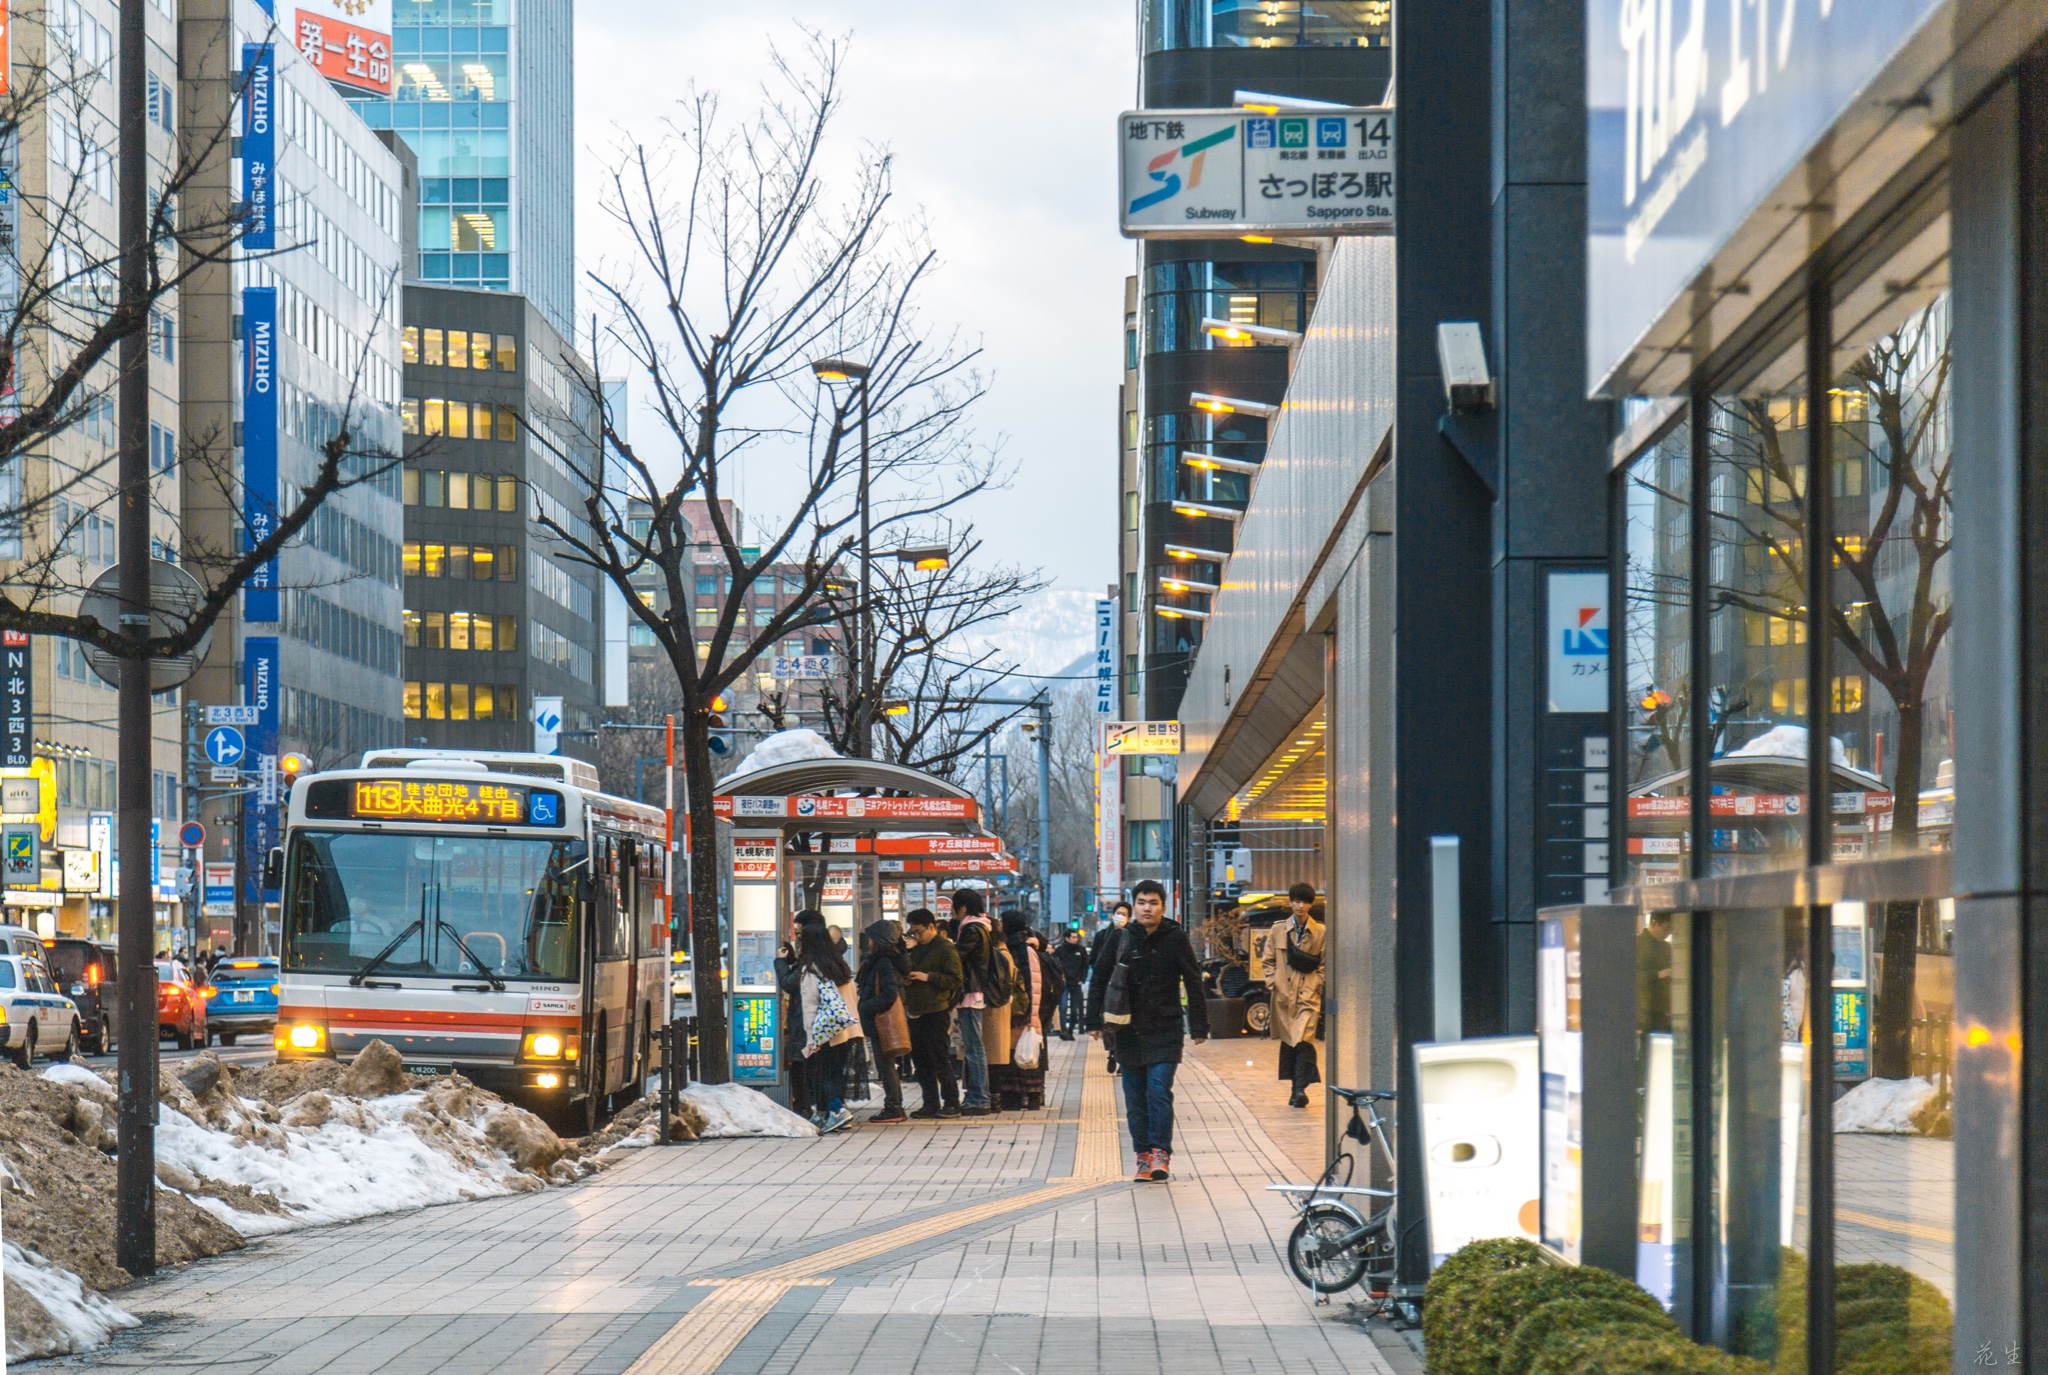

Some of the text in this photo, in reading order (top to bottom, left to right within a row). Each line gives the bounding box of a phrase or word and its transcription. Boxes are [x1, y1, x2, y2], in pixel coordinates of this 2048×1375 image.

[299, 19, 389, 84] 第一生命
[254, 66, 268, 133] MIZUHO
[1128, 121, 1185, 140] 地下鉄
[1354, 118, 1391, 147] 14
[1279, 151, 1387, 160] 南北線 東豊線 出入口
[1259, 172, 1393, 199] さっぽろ駅
[1185, 207, 1237, 220] Subway
[1307, 206, 1393, 219] Sapporo Sta.
[255, 321, 270, 393] MIZUHO
[1097, 601, 1112, 713] ニュー札幌ビル
[257, 658, 269, 710] MIZUHO
[1168, 724, 1179, 733] 13
[1143, 739, 1179, 747] さっぽろ駅
[7, 755, 28, 765] BLD.
[359, 785, 400, 809] 113
[406, 783, 509, 799] 桂台団地 経由
[402, 796, 518, 818] 大曲光4丁目
[816, 800, 843, 810] 札幌ドーム
[735, 847, 775, 857] 札幌駅前
